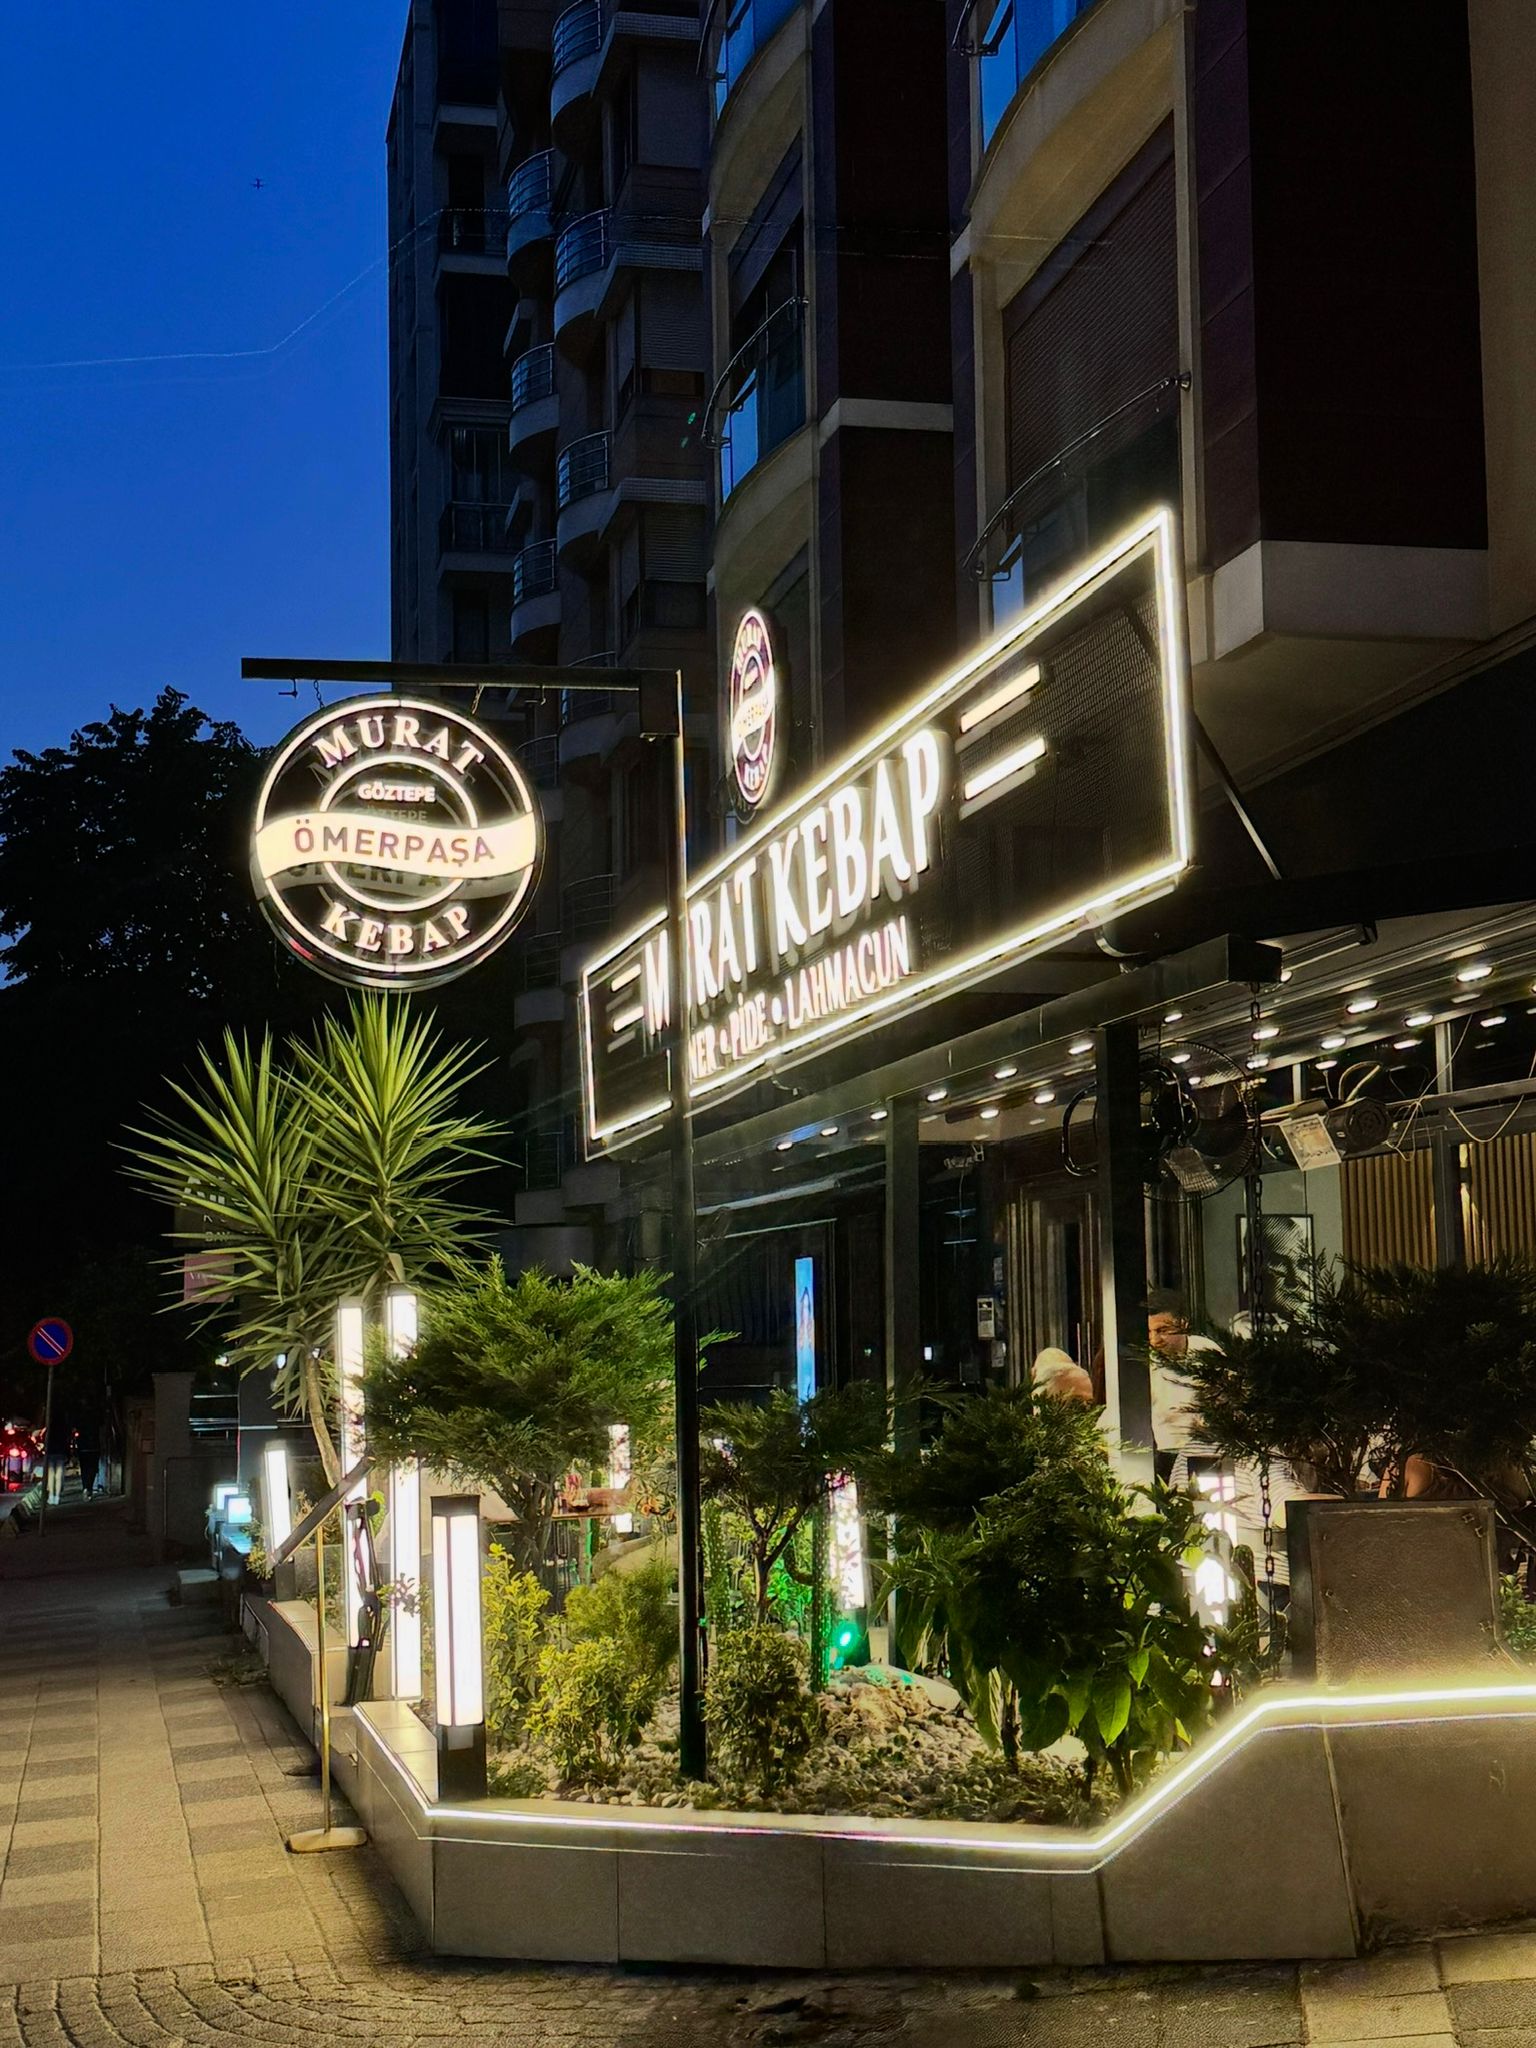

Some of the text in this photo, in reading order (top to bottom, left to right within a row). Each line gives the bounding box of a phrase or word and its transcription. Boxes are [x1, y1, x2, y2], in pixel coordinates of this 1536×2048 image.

[312, 714, 485, 775] MURAT
[357, 782, 437, 803] GÖZTEPE
[293, 818, 496, 867] ÖMERPAŞA
[645, 729, 941, 1036] MRAT KEBAP
[320, 901, 472, 955] KEBAP
[729, 991, 768, 1061] PİDE
[784, 915, 911, 1031] LAHMACUN
